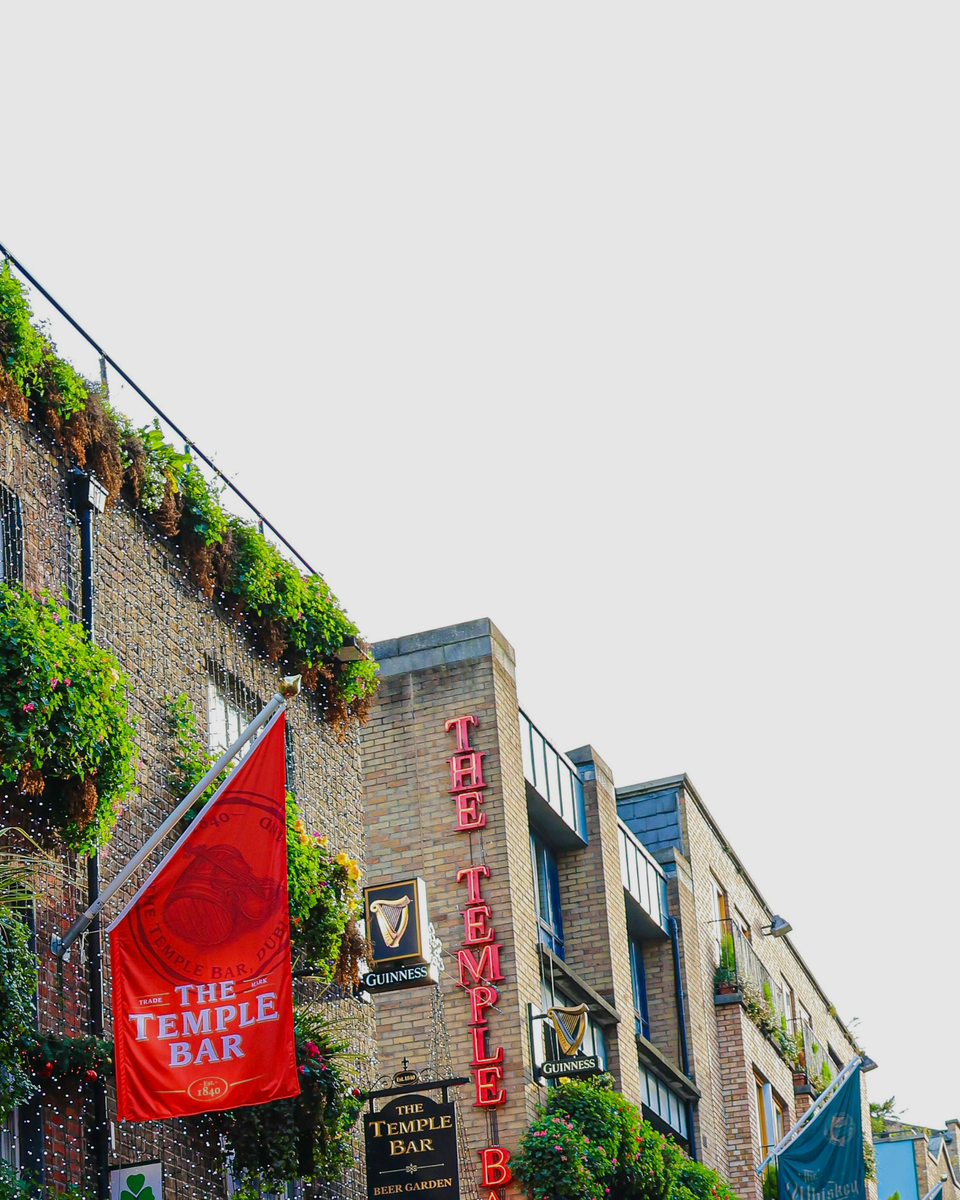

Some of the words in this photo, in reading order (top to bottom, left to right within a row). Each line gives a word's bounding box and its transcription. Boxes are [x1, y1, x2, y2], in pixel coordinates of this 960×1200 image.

[444, 713, 488, 832] THE
[149, 923, 204, 977] TEMPLE
[251, 977, 268, 988] MARK
[365, 966, 428, 987] GUINNESS
[455, 864, 507, 1108] TEMPLE
[139, 997, 163, 1006] TRADE
[174, 979, 236, 1007] THE
[128, 992, 279, 1042] TEMPLE
[168, 1033, 246, 1068] BAR
[543, 1058, 596, 1074] GUINNESS
[197, 1086, 221, 1097] 1840
[395, 1103, 424, 1115] THE
[368, 1115, 453, 1138] TEMPLE
[389, 1138, 434, 1156] BAR
[373, 1184, 403, 1196] BEER
[405, 1178, 452, 1192] GARDEN
